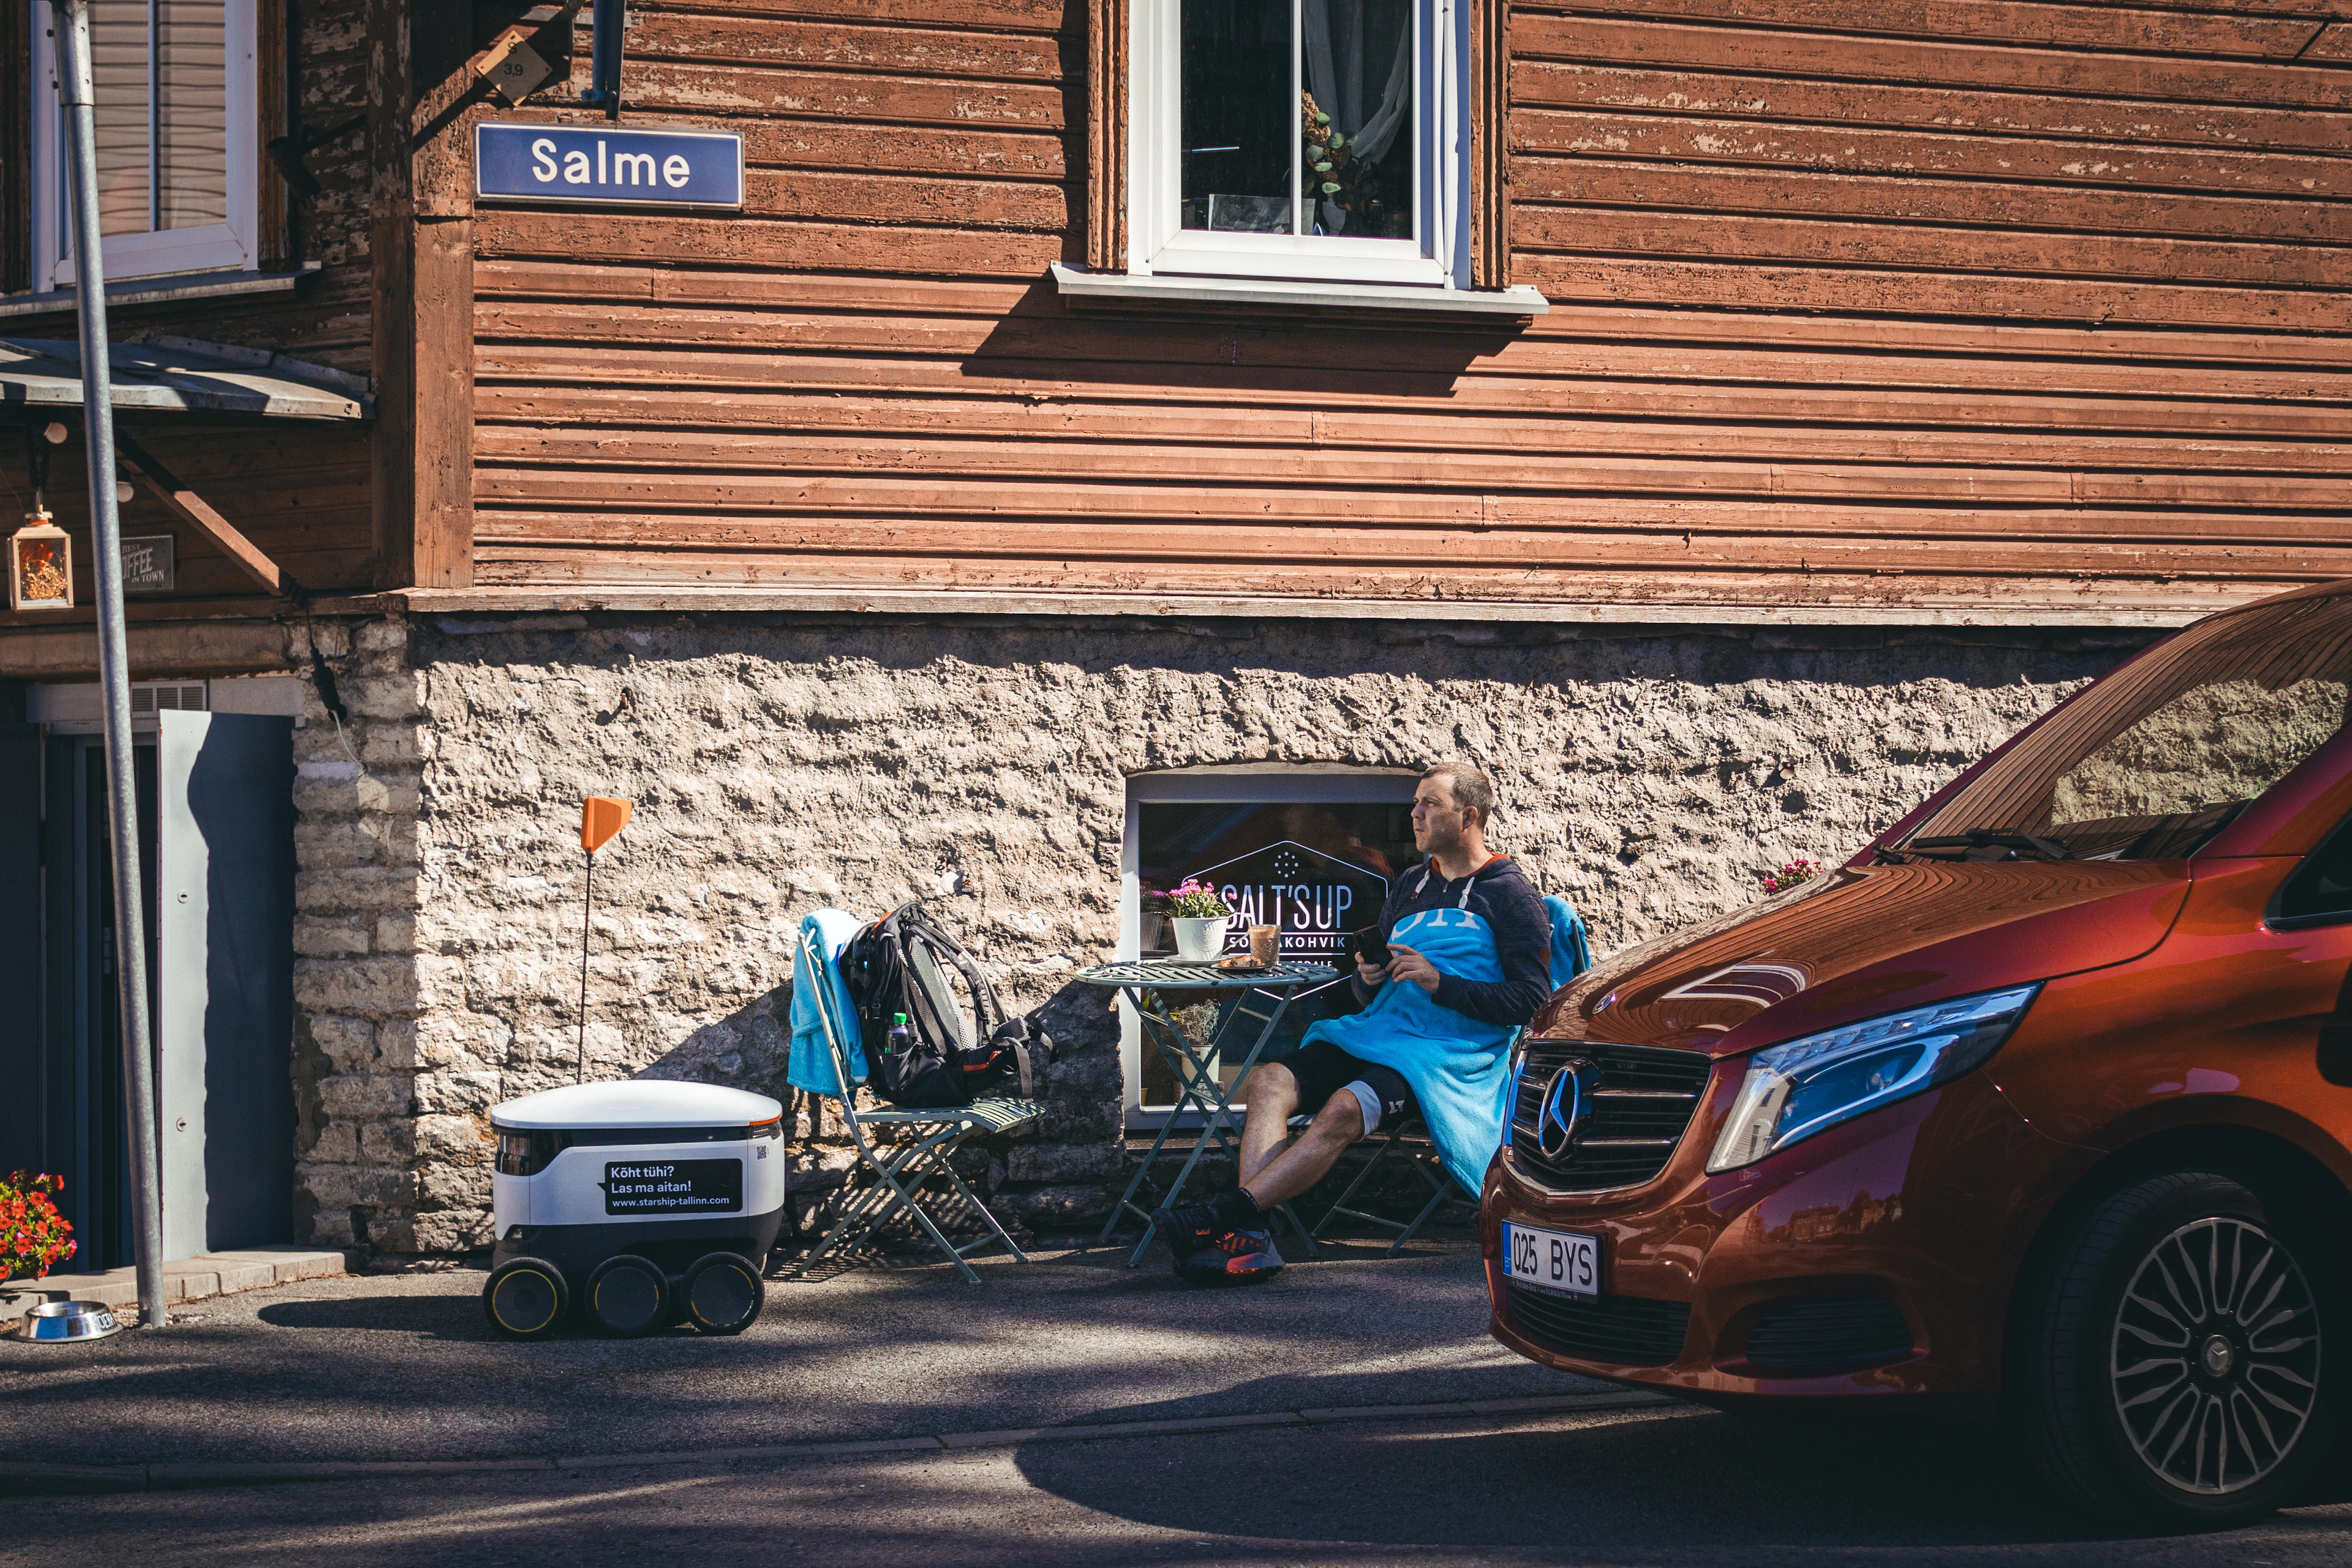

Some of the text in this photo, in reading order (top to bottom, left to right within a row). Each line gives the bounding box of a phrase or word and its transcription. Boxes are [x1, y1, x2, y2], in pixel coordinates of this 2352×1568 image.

[508, 42, 518, 54] S
[503, 63, 523, 77] 3,9
[532, 138, 690, 188] Salme
[122, 547, 153, 579] OFFEE
[141, 569, 165, 582] TOWN
[1229, 937, 1345, 948] SOKOHVIK
[611, 1166, 674, 1178] Kõht tühi?
[611, 1181, 692, 1193] Las ma aitan!
[612, 1197, 729, 1207] www.starship-tallinn.com
[1513, 1231, 1593, 1286] 025 BYS
